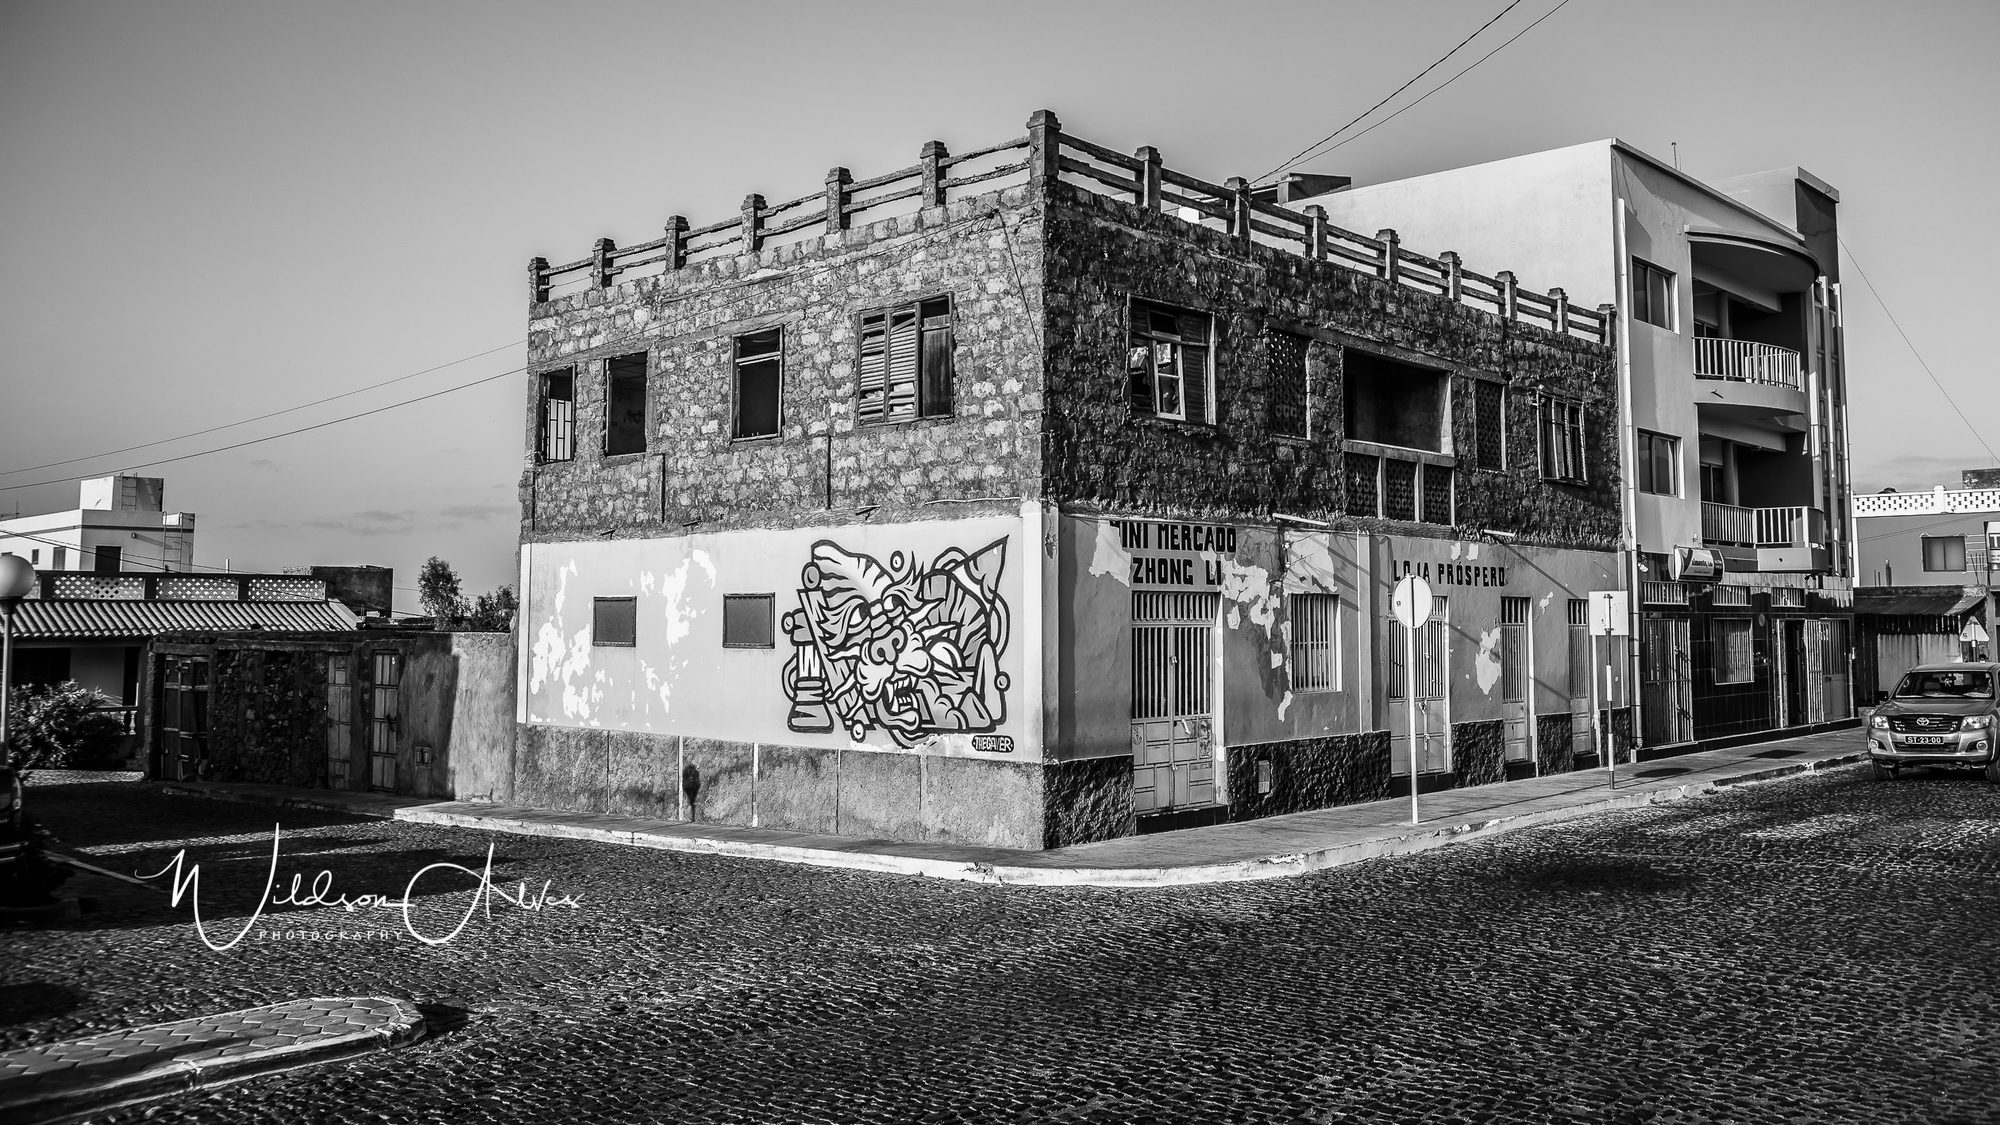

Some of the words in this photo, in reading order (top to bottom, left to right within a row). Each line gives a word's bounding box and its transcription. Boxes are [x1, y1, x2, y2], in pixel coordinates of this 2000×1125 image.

[1110, 520, 1148, 548] INI
[1158, 524, 1236, 552] MERCADO
[1133, 557, 1193, 585] ZHONG
[1438, 561, 1505, 587] PRÓSPERO
